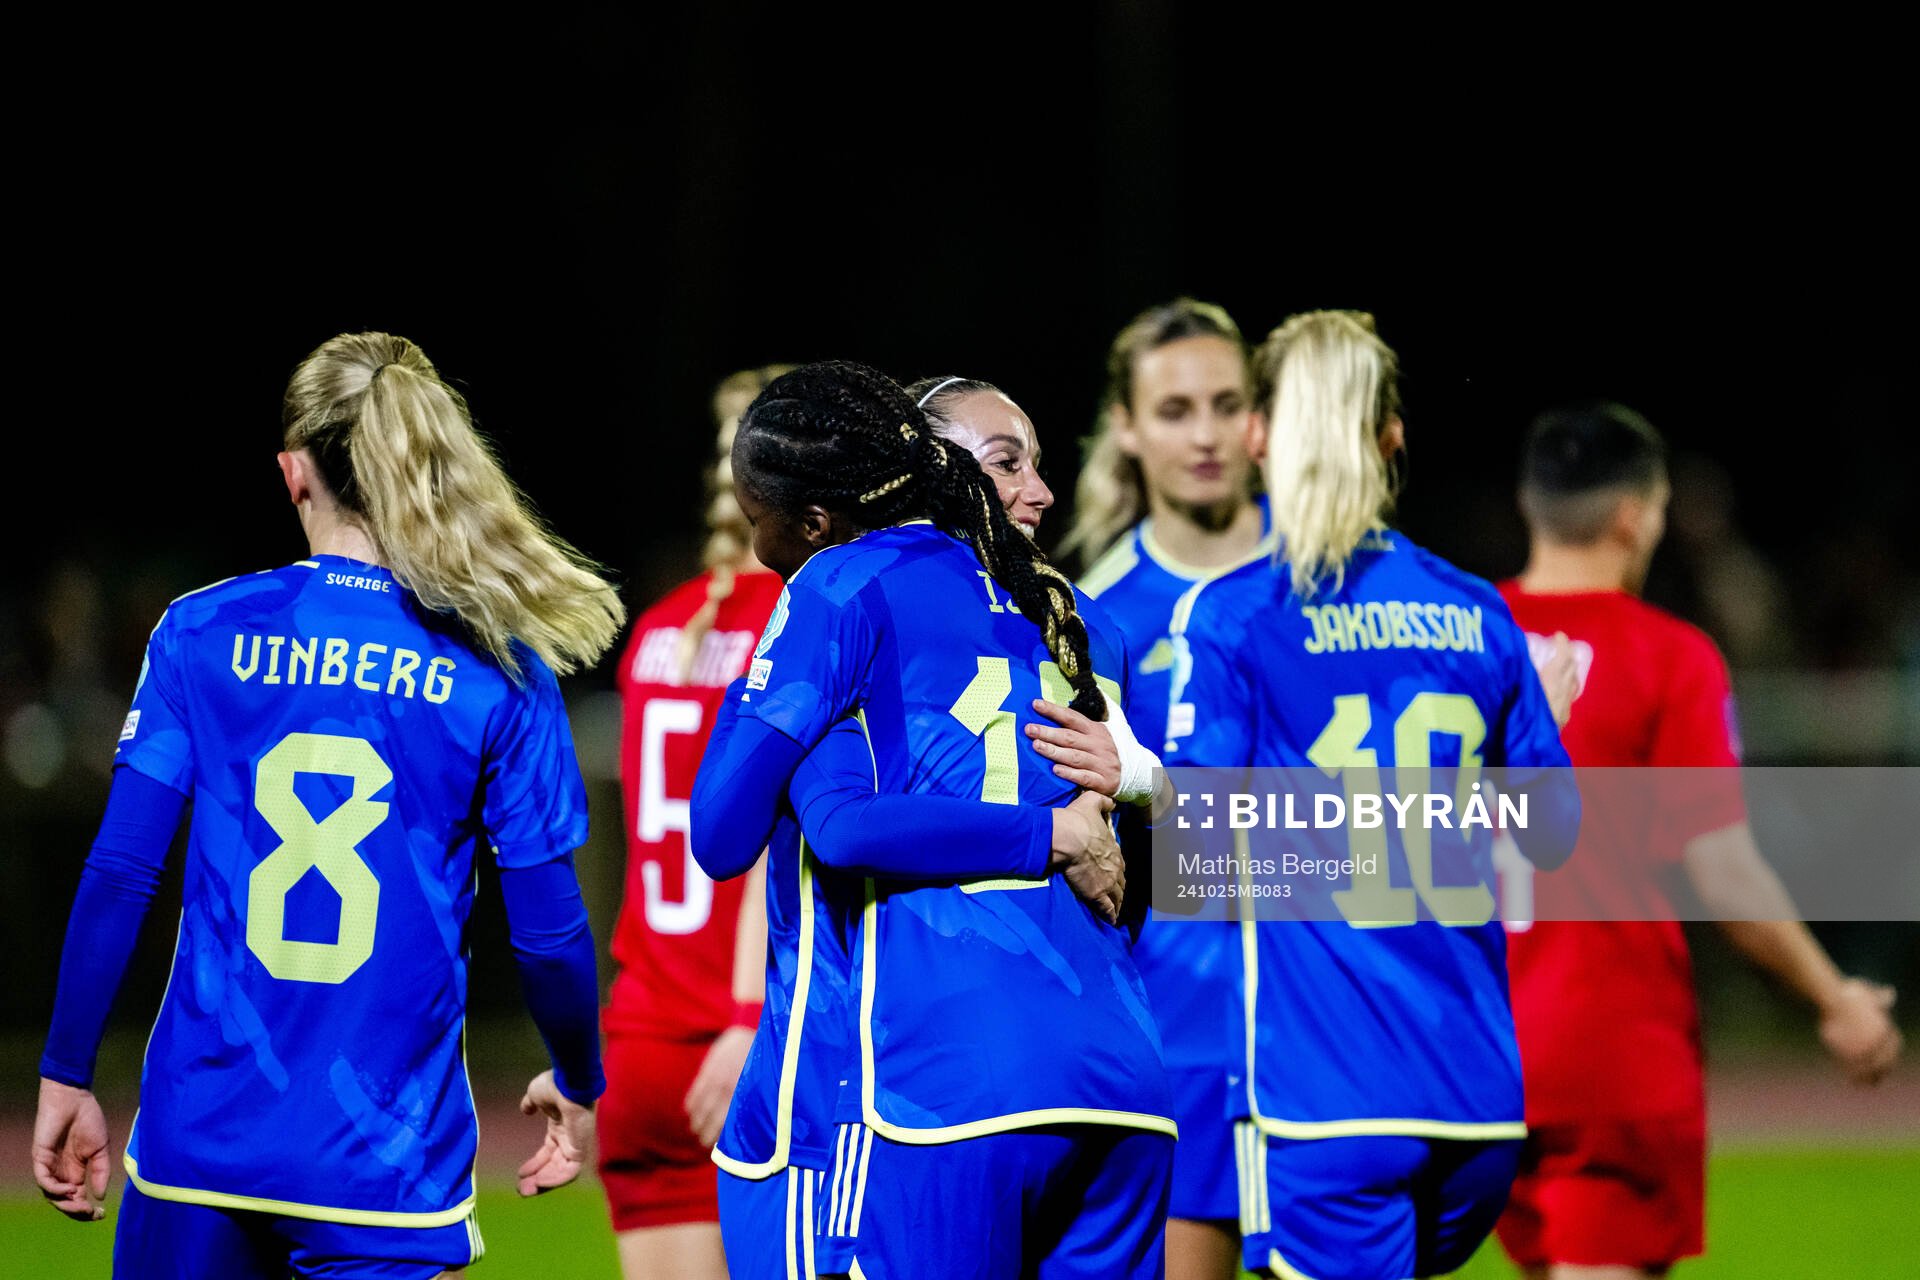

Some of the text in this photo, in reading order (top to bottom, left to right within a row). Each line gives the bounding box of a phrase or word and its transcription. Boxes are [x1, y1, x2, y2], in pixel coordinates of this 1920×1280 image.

[325, 572, 392, 594] SVERIGE
[1303, 602, 1484, 654] JAKOBSSON
[231, 634, 456, 704] VINBERG
[246, 732, 393, 984] 8
[637, 698, 714, 935] 5
[1307, 692, 1495, 929] 10
